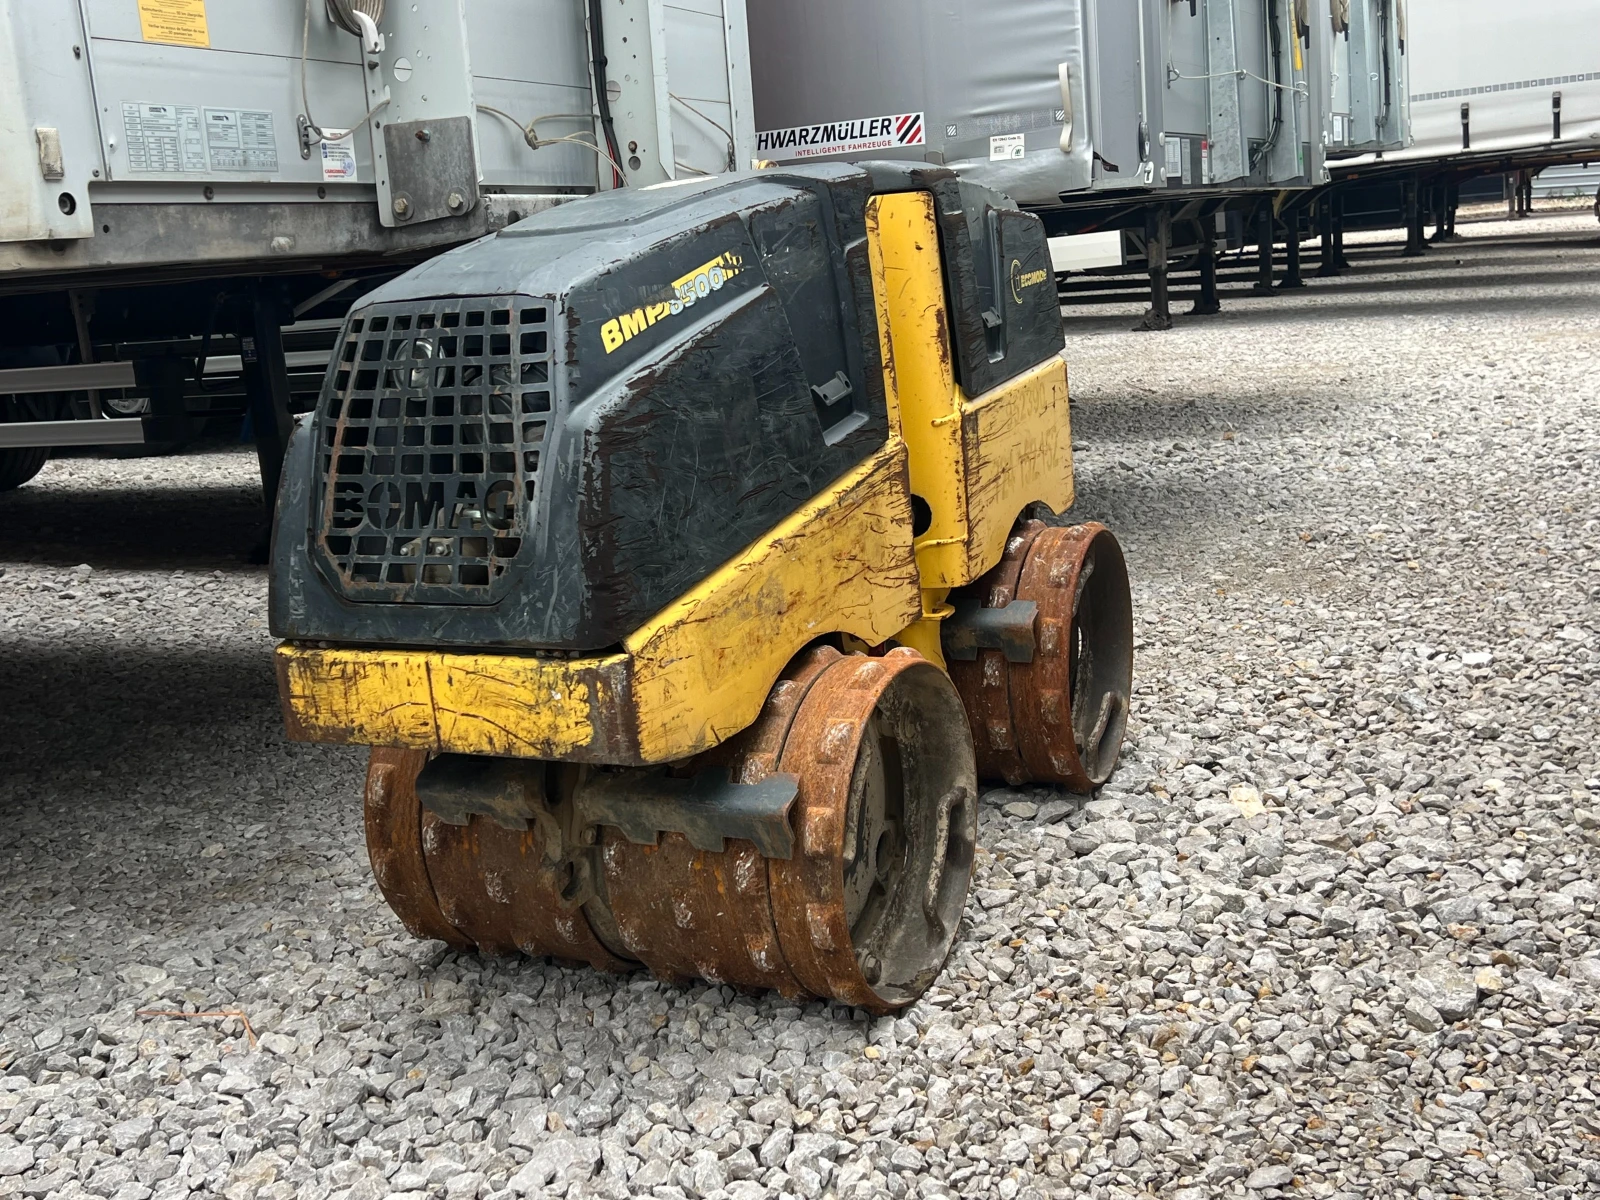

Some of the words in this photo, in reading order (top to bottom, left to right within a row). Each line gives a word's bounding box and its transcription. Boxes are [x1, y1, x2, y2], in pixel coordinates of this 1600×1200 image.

[755, 117, 892, 151] HWARZMÜLLER
[795, 144, 846, 157] INTELLIGENTE
[847, 139, 893, 152] FAHRZEUGE
[332, 479, 516, 531] BOMAG
